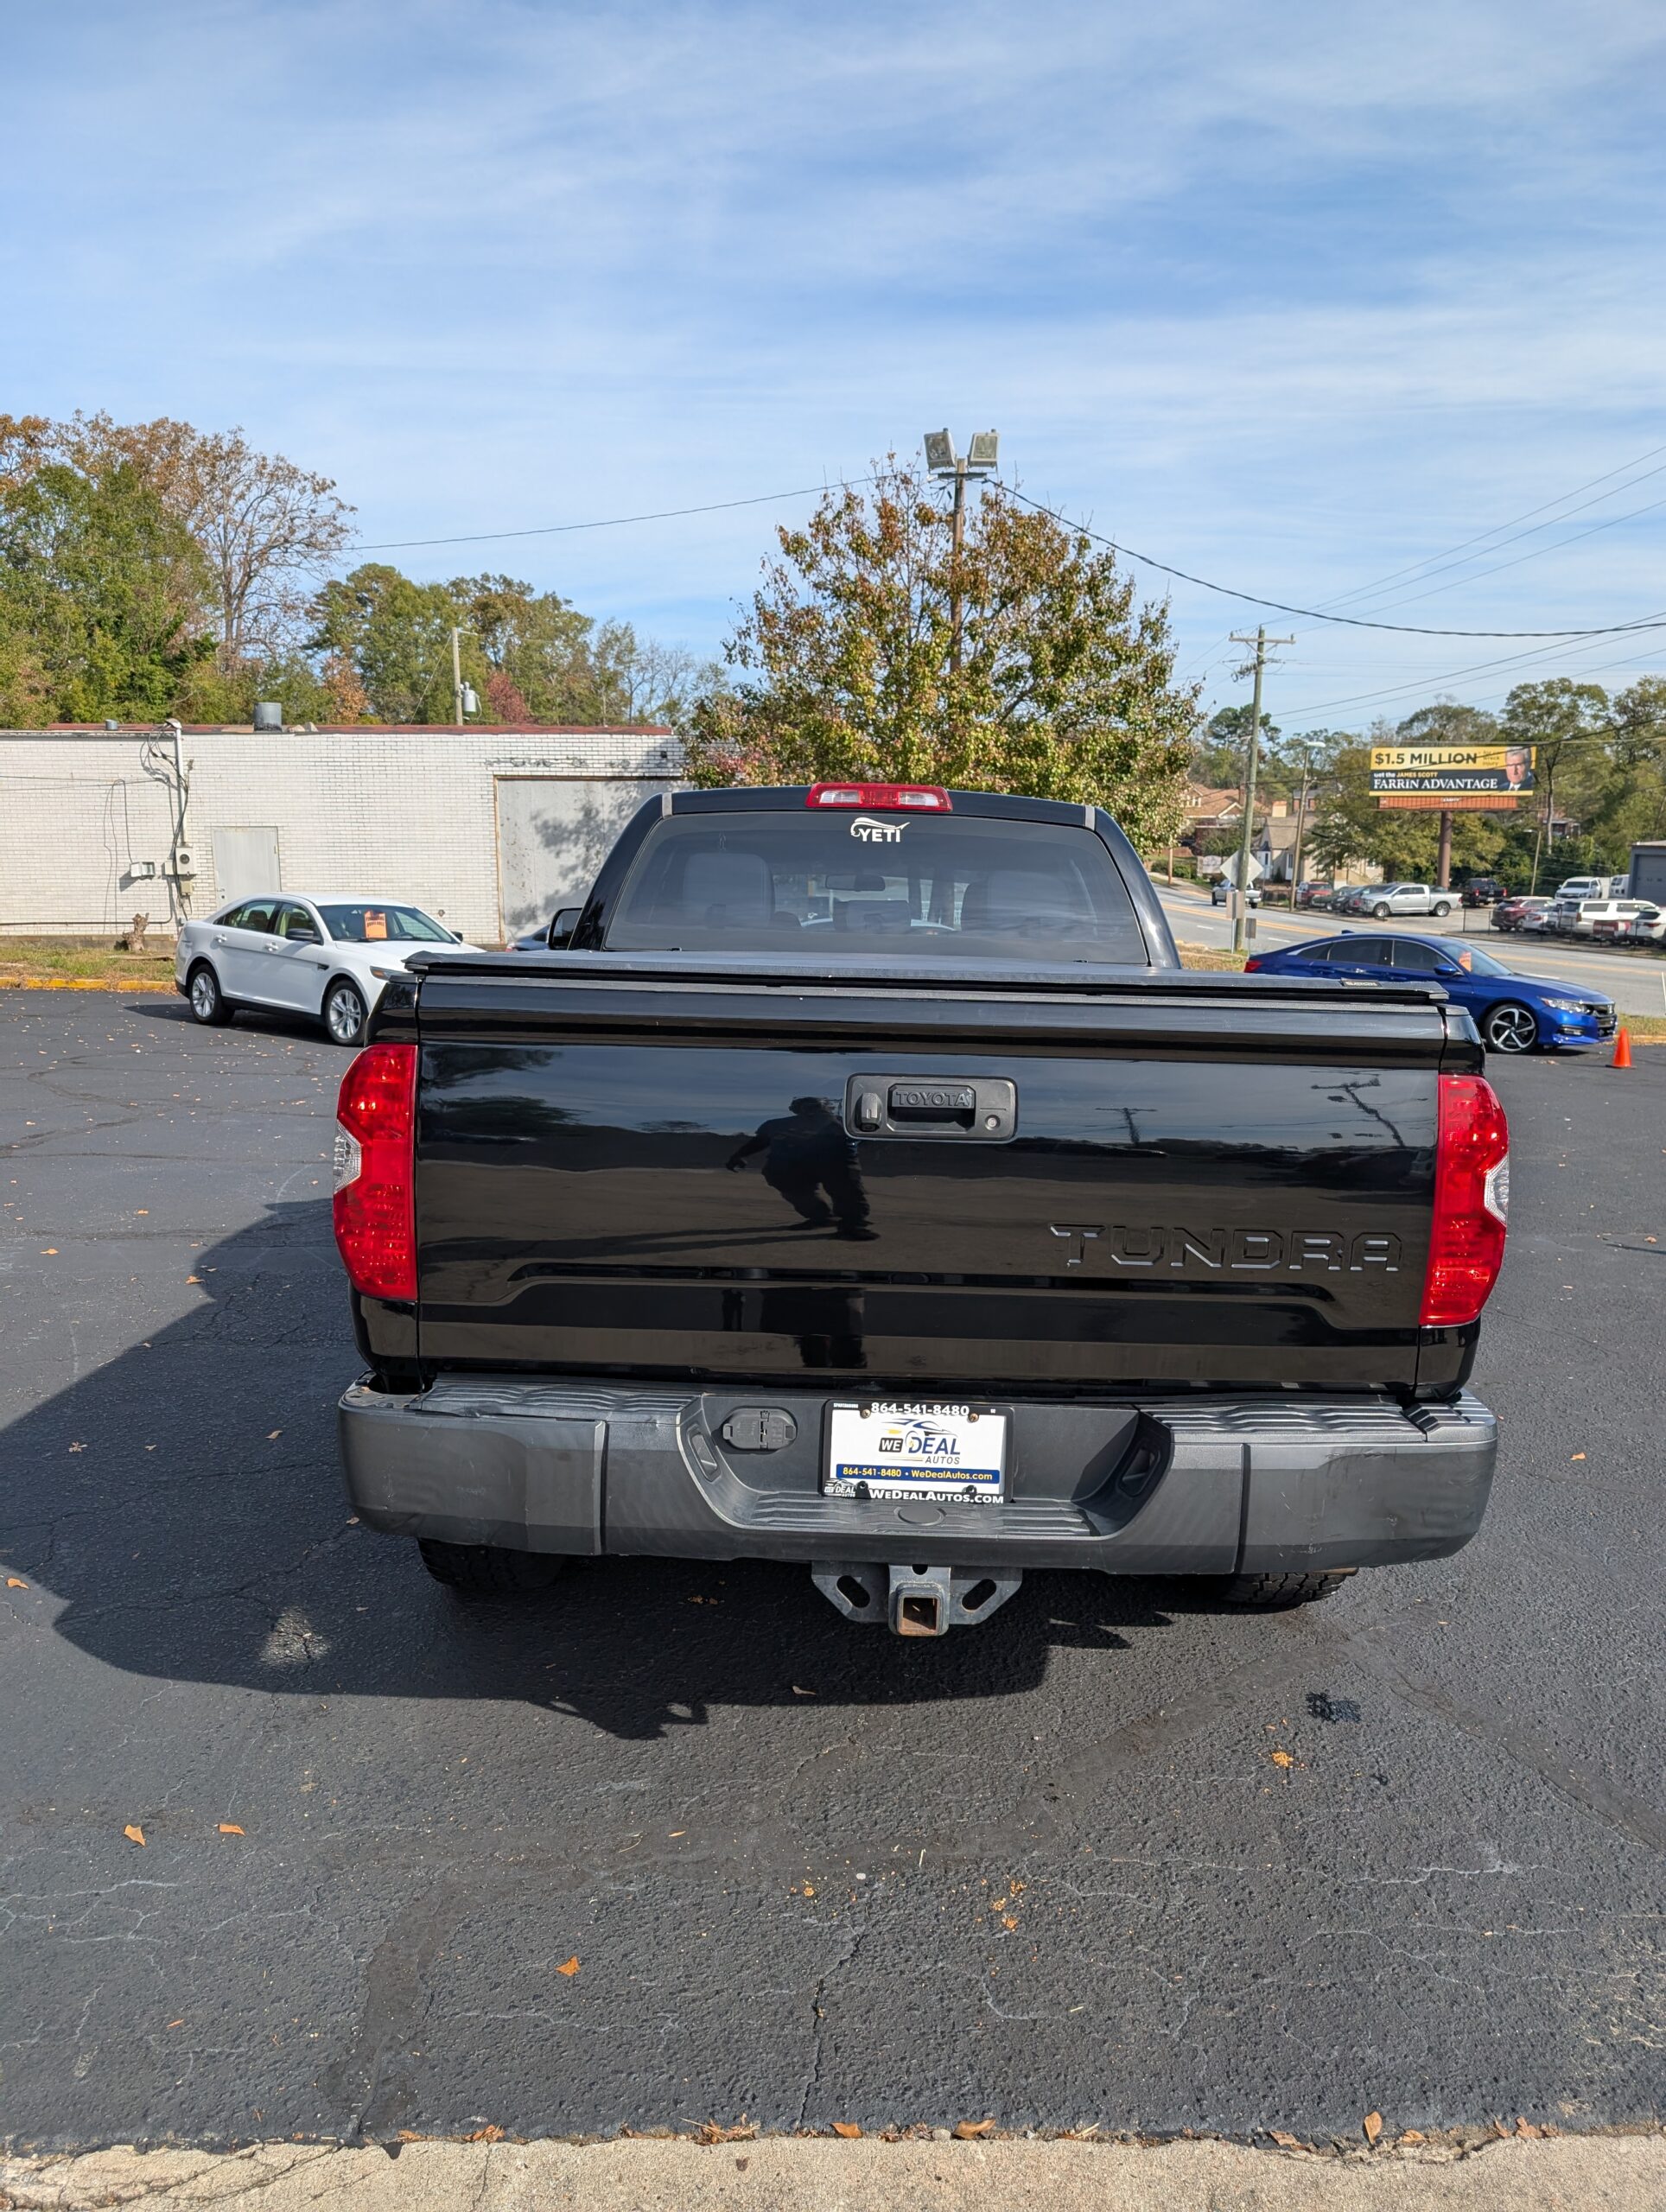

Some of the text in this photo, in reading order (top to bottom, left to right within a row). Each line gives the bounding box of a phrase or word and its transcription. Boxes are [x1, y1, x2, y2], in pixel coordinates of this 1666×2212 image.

[1375, 753, 1404, 765] $1.5
[1410, 753, 1477, 765] MILLION
[1374, 779, 1497, 789] FARRIN ADVANTAGE
[859, 828, 900, 842] YETI
[895, 1091, 971, 1107] TOYOTA
[1049, 1222, 1403, 1272] TUNDRA
[870, 1402, 970, 1416] 864-541-8480
[881, 1436, 961, 1455] WE DEAL
[925, 1455, 961, 1465] AUTOS
[843, 1466, 993, 1480] 864-541-8480 WeDealAutos.com
